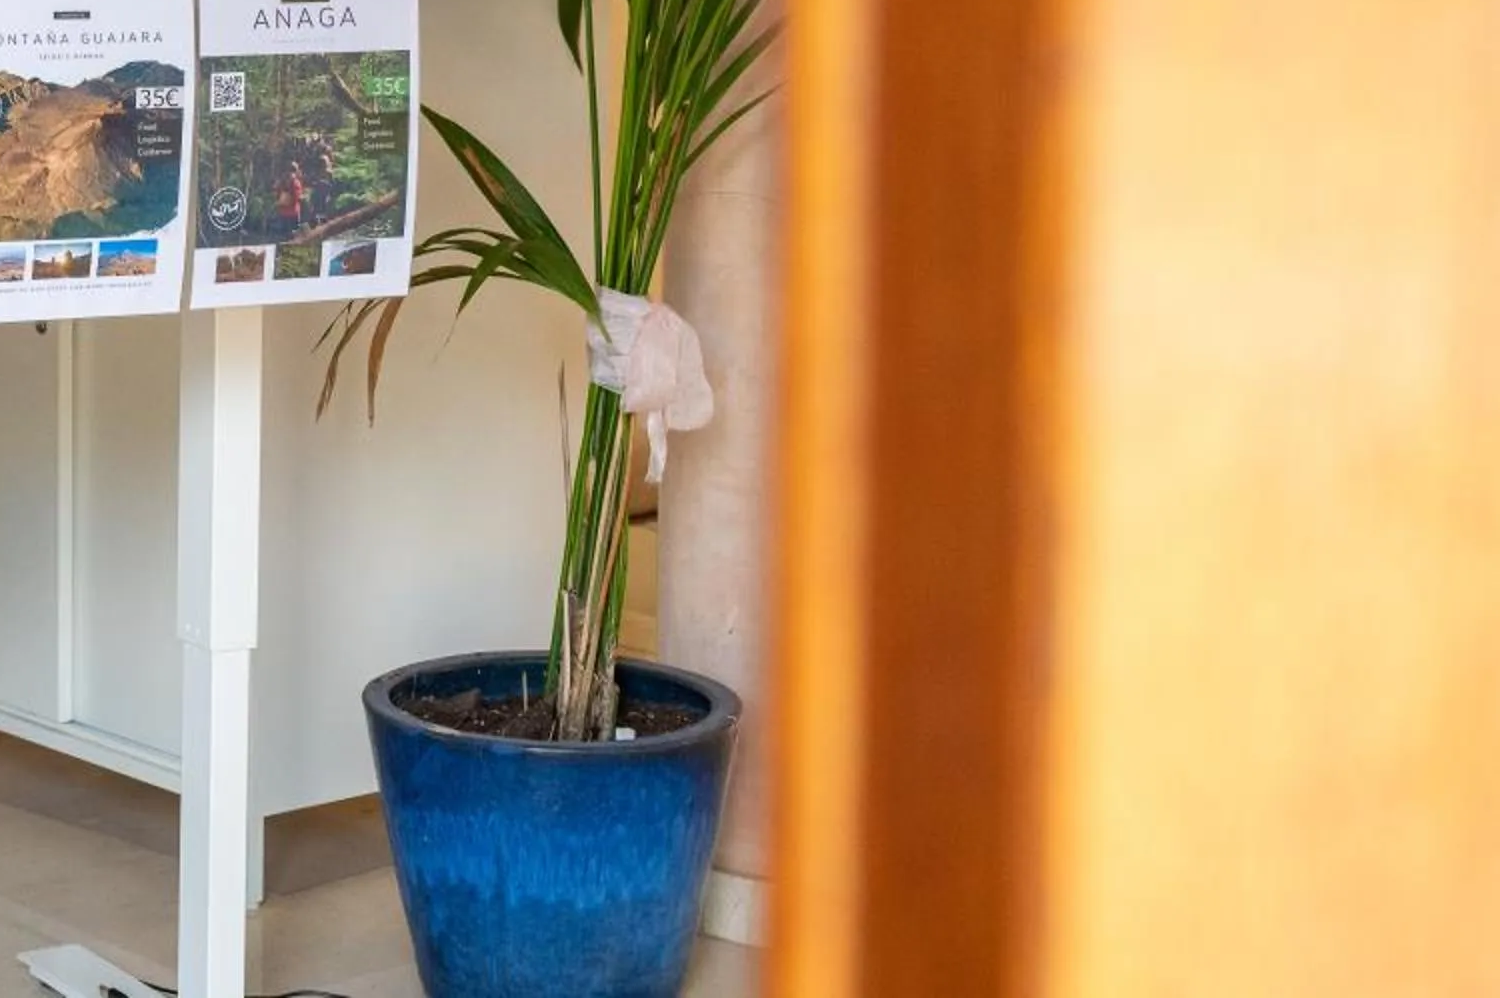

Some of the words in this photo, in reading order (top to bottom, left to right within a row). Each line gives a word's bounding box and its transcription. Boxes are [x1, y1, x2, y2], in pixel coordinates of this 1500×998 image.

[253, 6, 357, 29] ANAGA
[80, 31, 164, 45] GUAJARA
[372, 77, 405, 95] 35€
[139, 89, 179, 107] 35€
